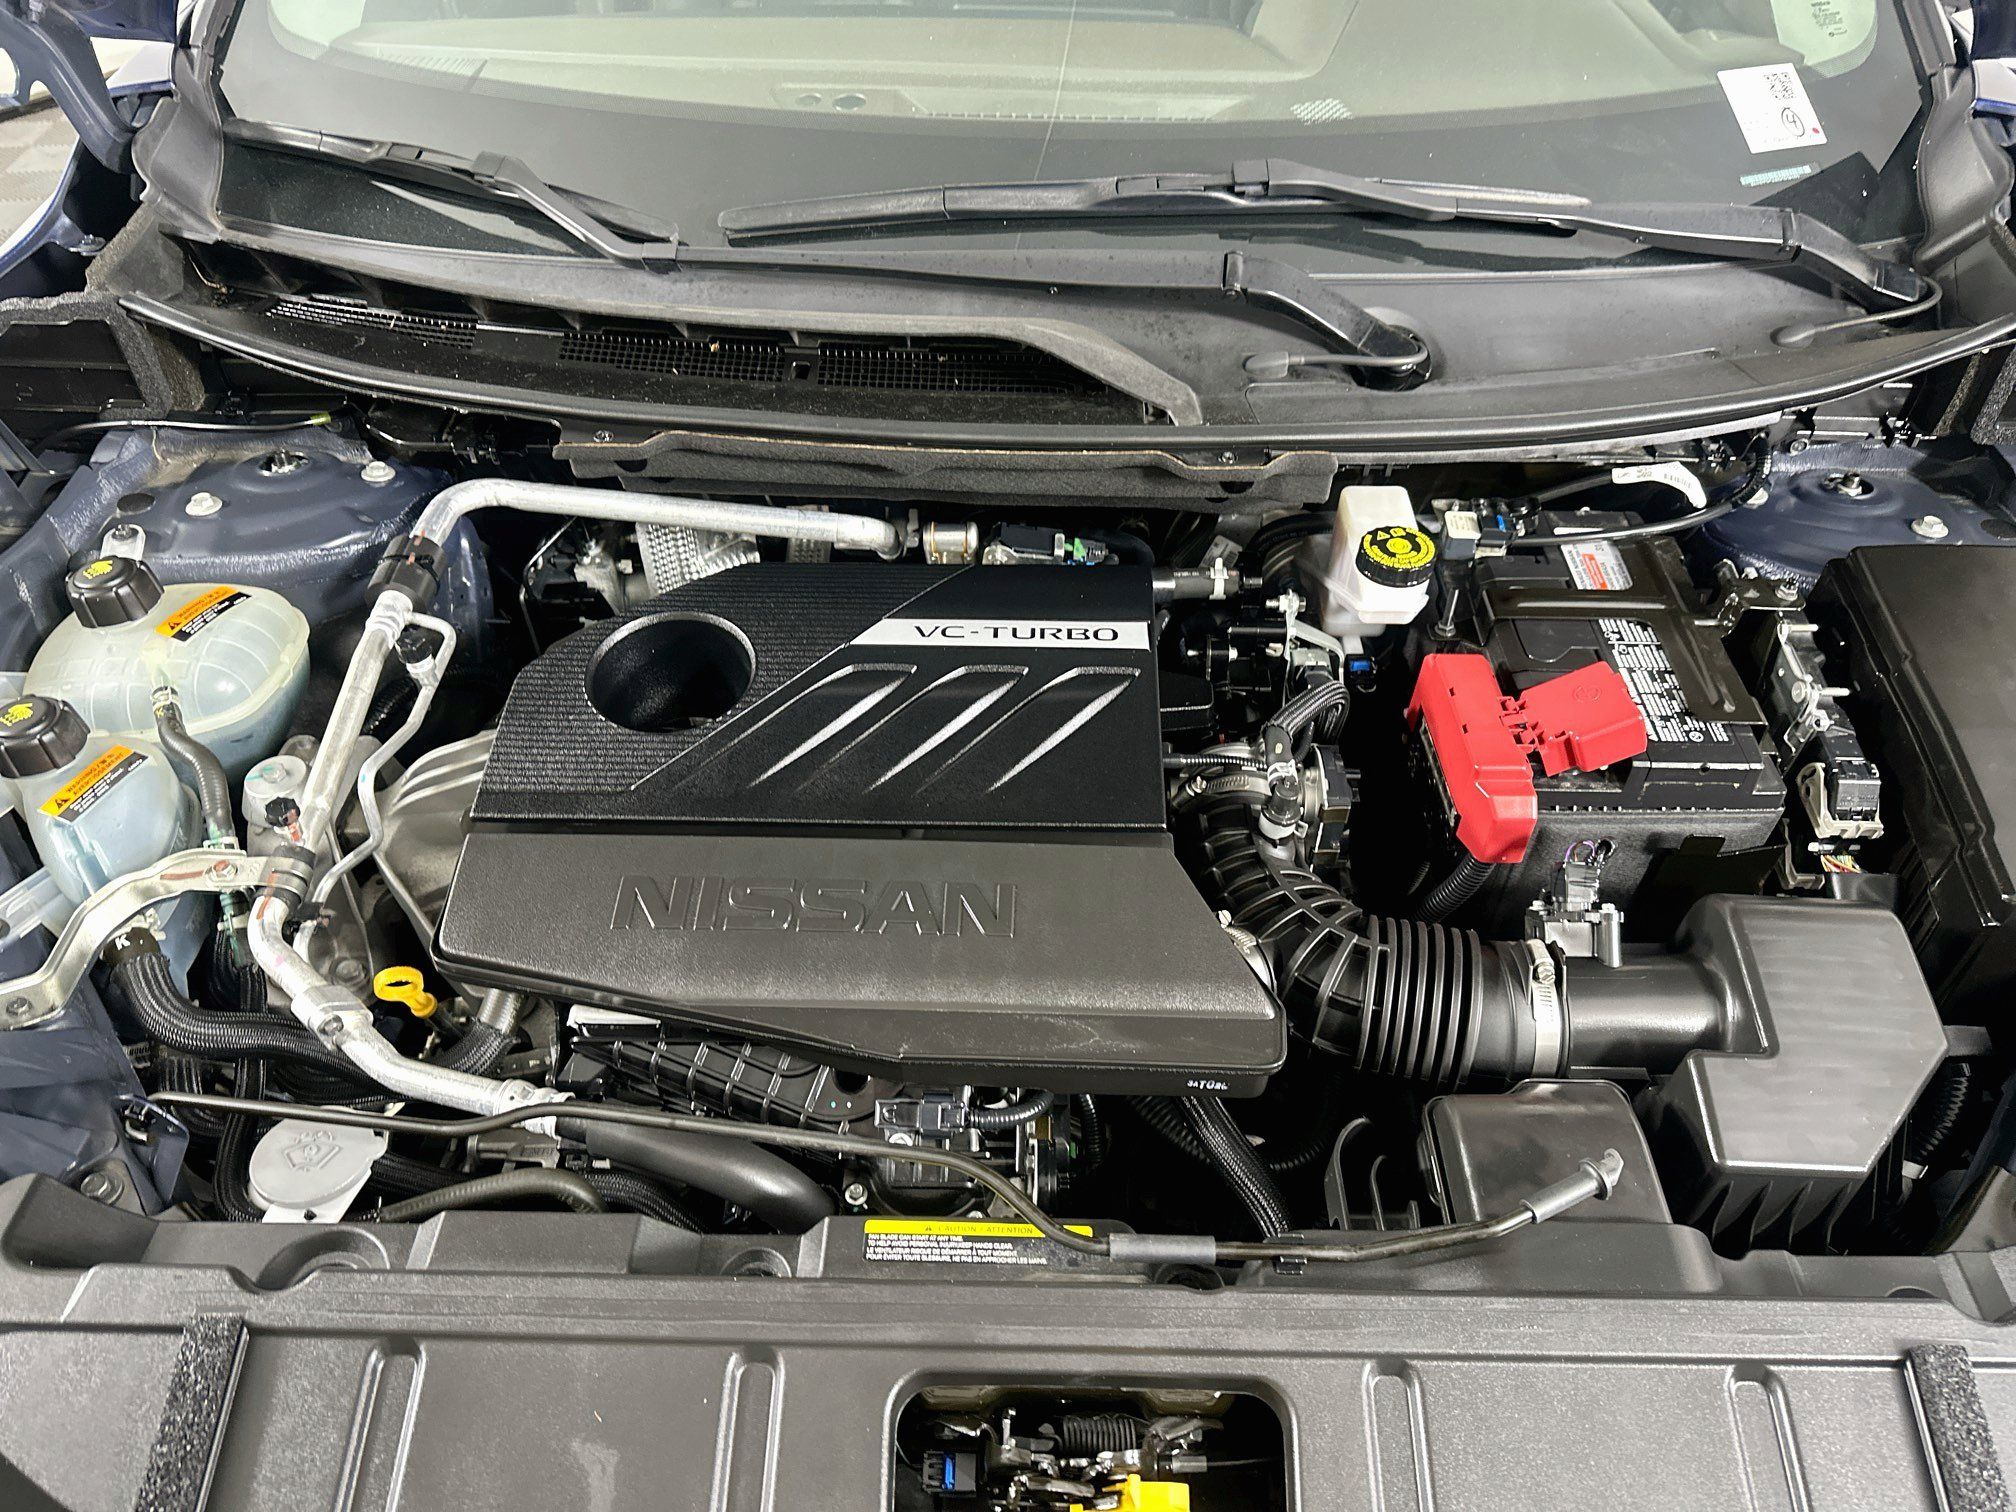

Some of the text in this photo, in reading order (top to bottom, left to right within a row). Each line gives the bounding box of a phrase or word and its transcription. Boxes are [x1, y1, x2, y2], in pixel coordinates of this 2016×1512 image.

[1785, 113, 1799, 129] 4
[914, 625, 1119, 641] VC-TURBO
[610, 875, 1017, 938] NISSAN
[114, 934, 131, 950] K
[986, 1225, 1033, 1233] ATTENTION
[982, 1256, 1017, 1264] APPROCHER
